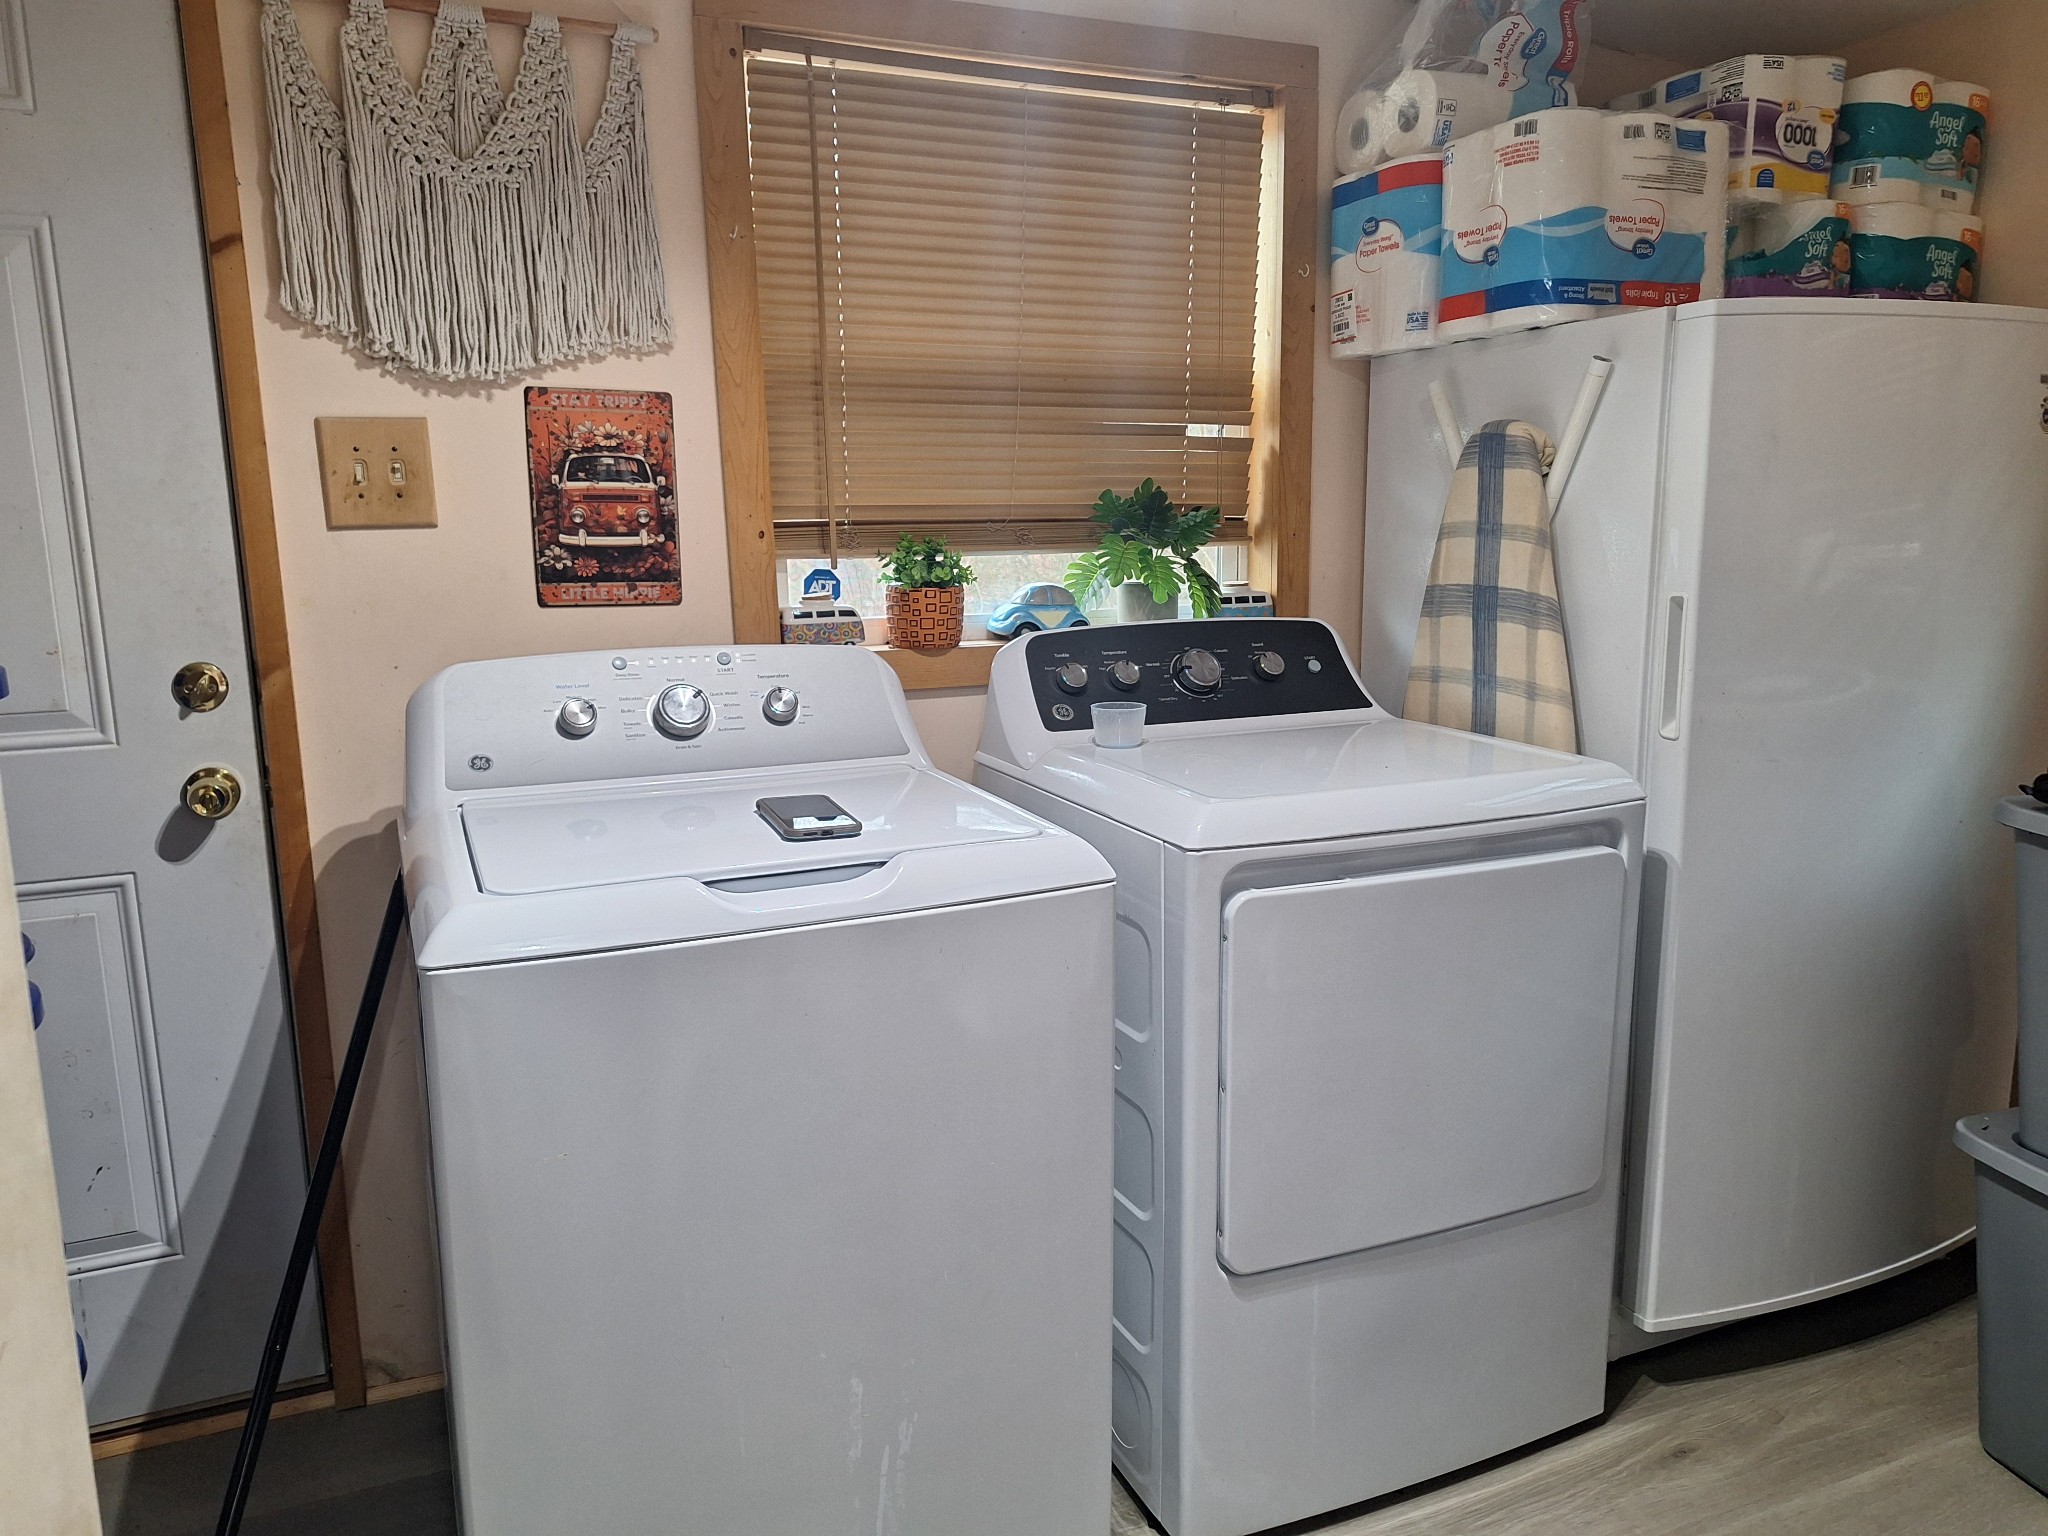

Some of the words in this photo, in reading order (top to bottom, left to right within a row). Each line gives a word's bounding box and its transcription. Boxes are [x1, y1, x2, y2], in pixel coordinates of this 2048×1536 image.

[1563, 9, 1573, 38] Triple
[1496, 21, 1520, 54] Paper
[1929, 110, 1966, 132] Angel
[1783, 122, 1817, 147] 1000
[1935, 127, 1958, 147] Soft
[1608, 215, 1637, 225] Towels
[1639, 216, 1660, 227] Paper
[1457, 227, 1485, 240] Towels
[1360, 246, 1378, 258] Paper
[1378, 241, 1400, 253] Towels
[1804, 240, 1828, 258] Soft
[1926, 244, 1958, 265] Angel
[1931, 260, 1953, 279] Soft
[1664, 292, 1678, 304] 18
[1407, 316, 1420, 324] USA
[550, 393, 591, 407] STAY
[596, 395, 649, 408] TRIPPY
[560, 587, 608, 600] LITTLE
[612, 587, 661, 600] HIPPIE
[809, 579, 836, 594] ADT
